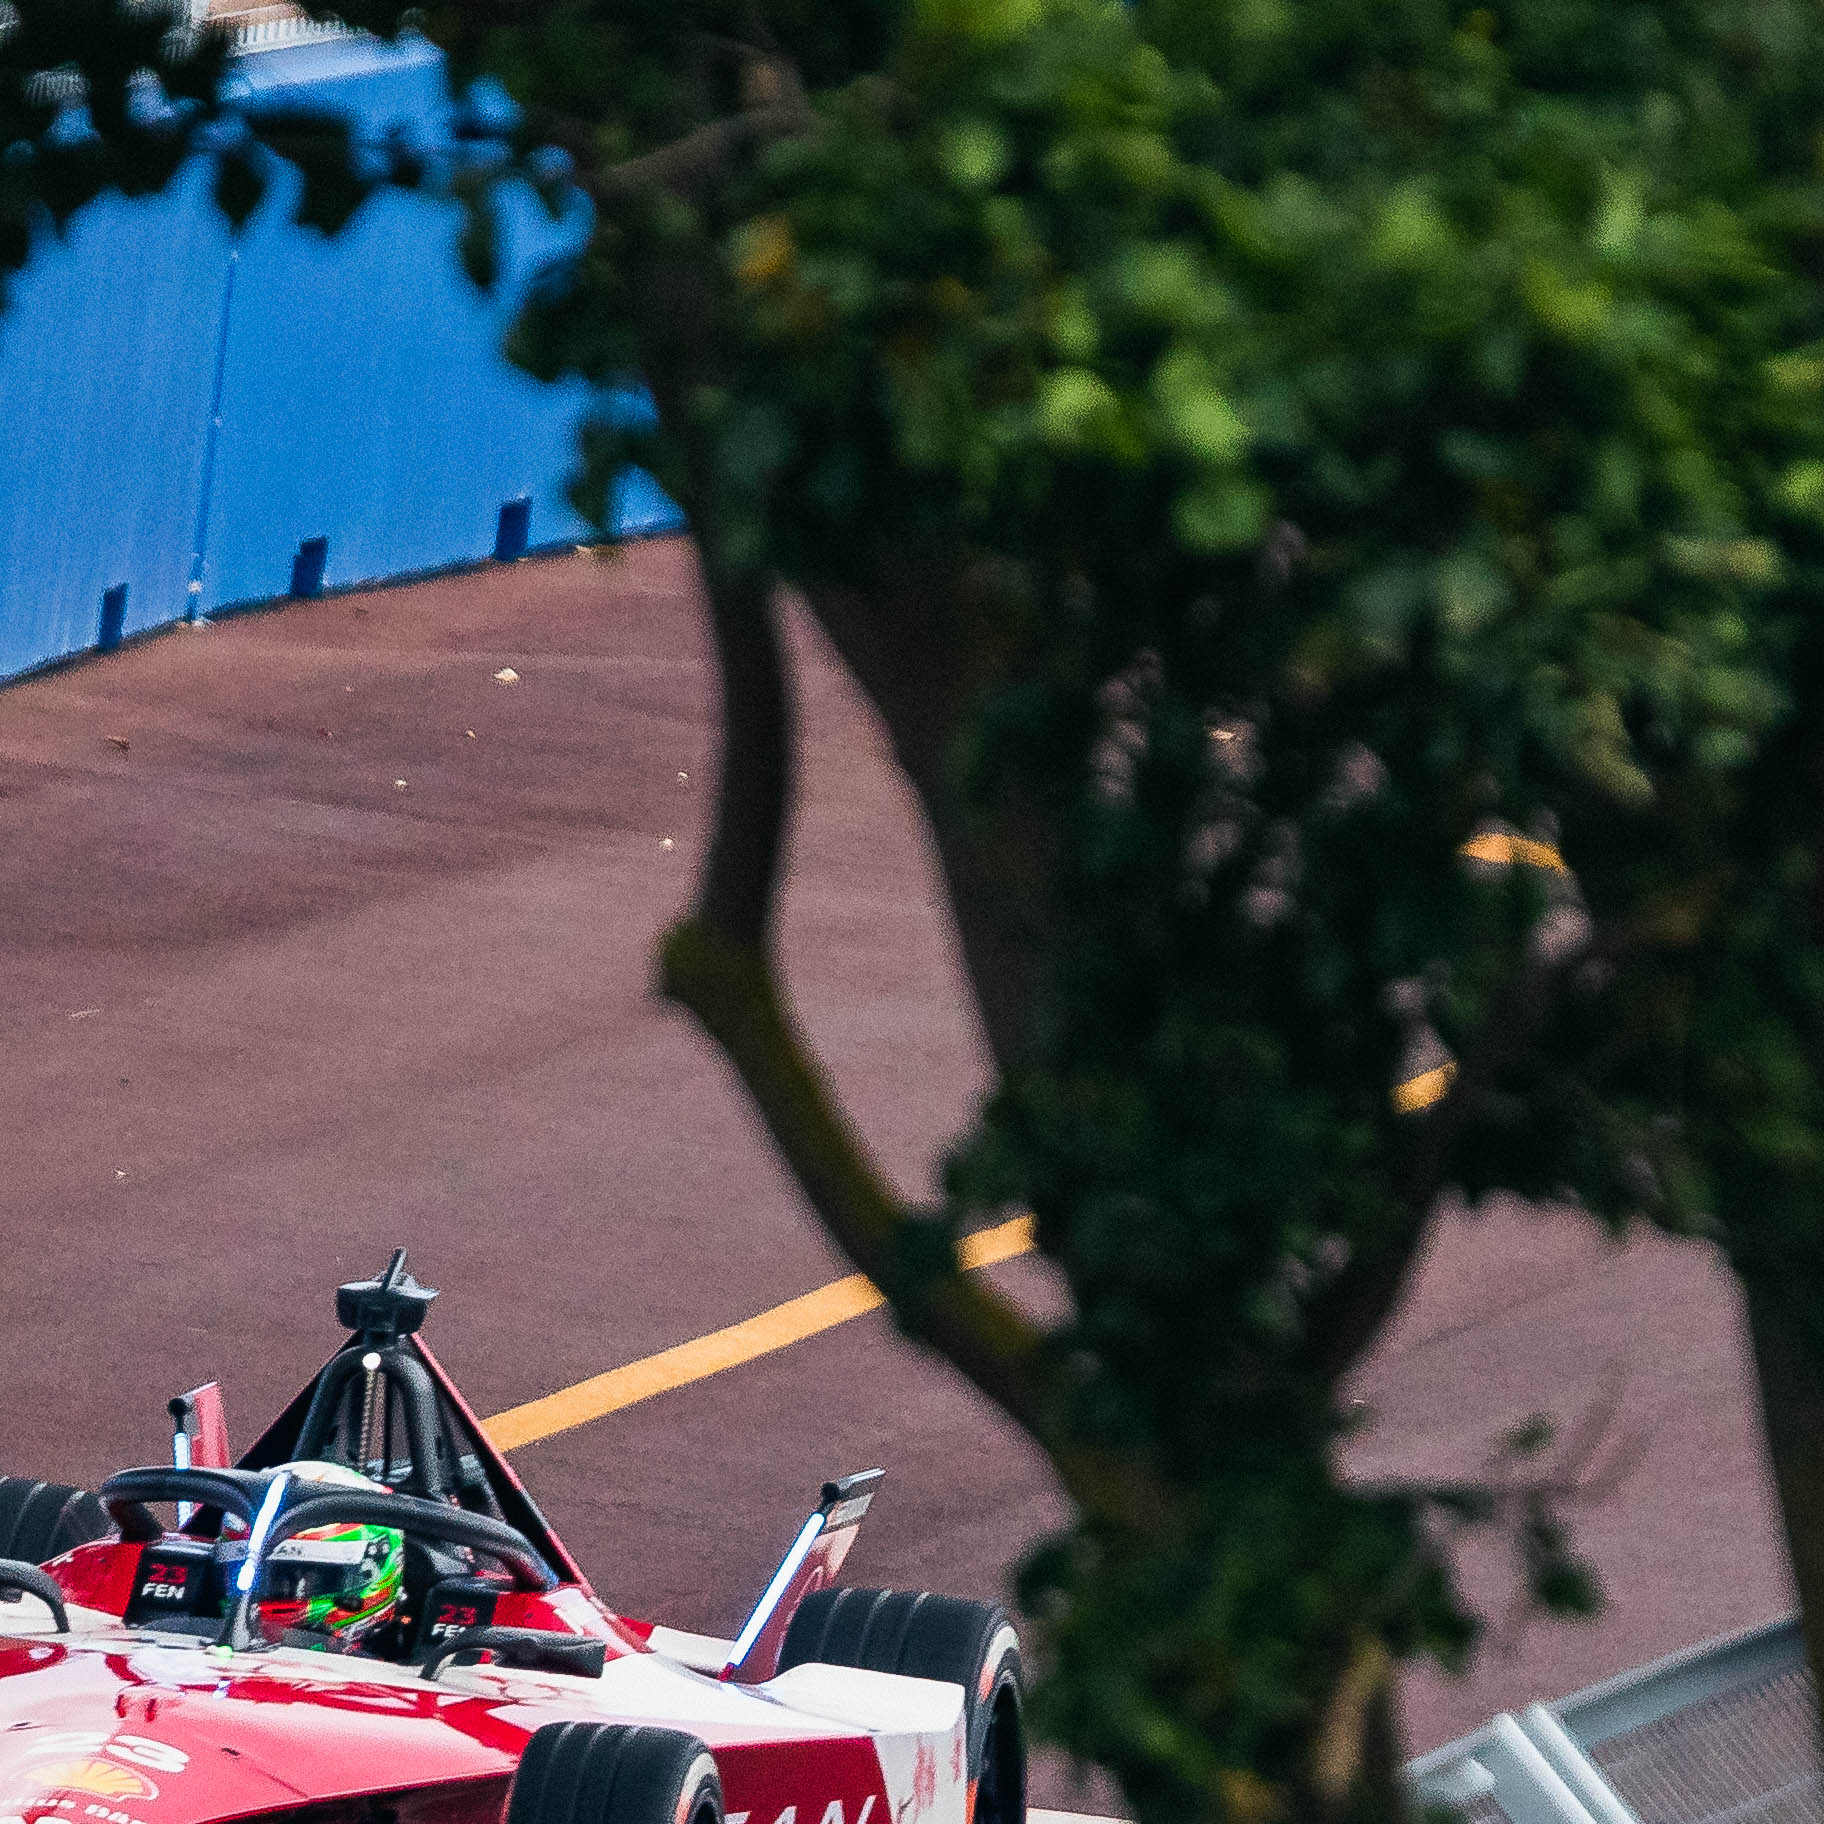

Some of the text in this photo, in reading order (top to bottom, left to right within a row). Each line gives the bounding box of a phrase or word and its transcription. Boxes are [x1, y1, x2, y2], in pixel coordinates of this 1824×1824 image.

[148, 1562, 188, 1583] 23
[141, 1583, 186, 1600] FEN
[437, 1603, 475, 1625] 23
